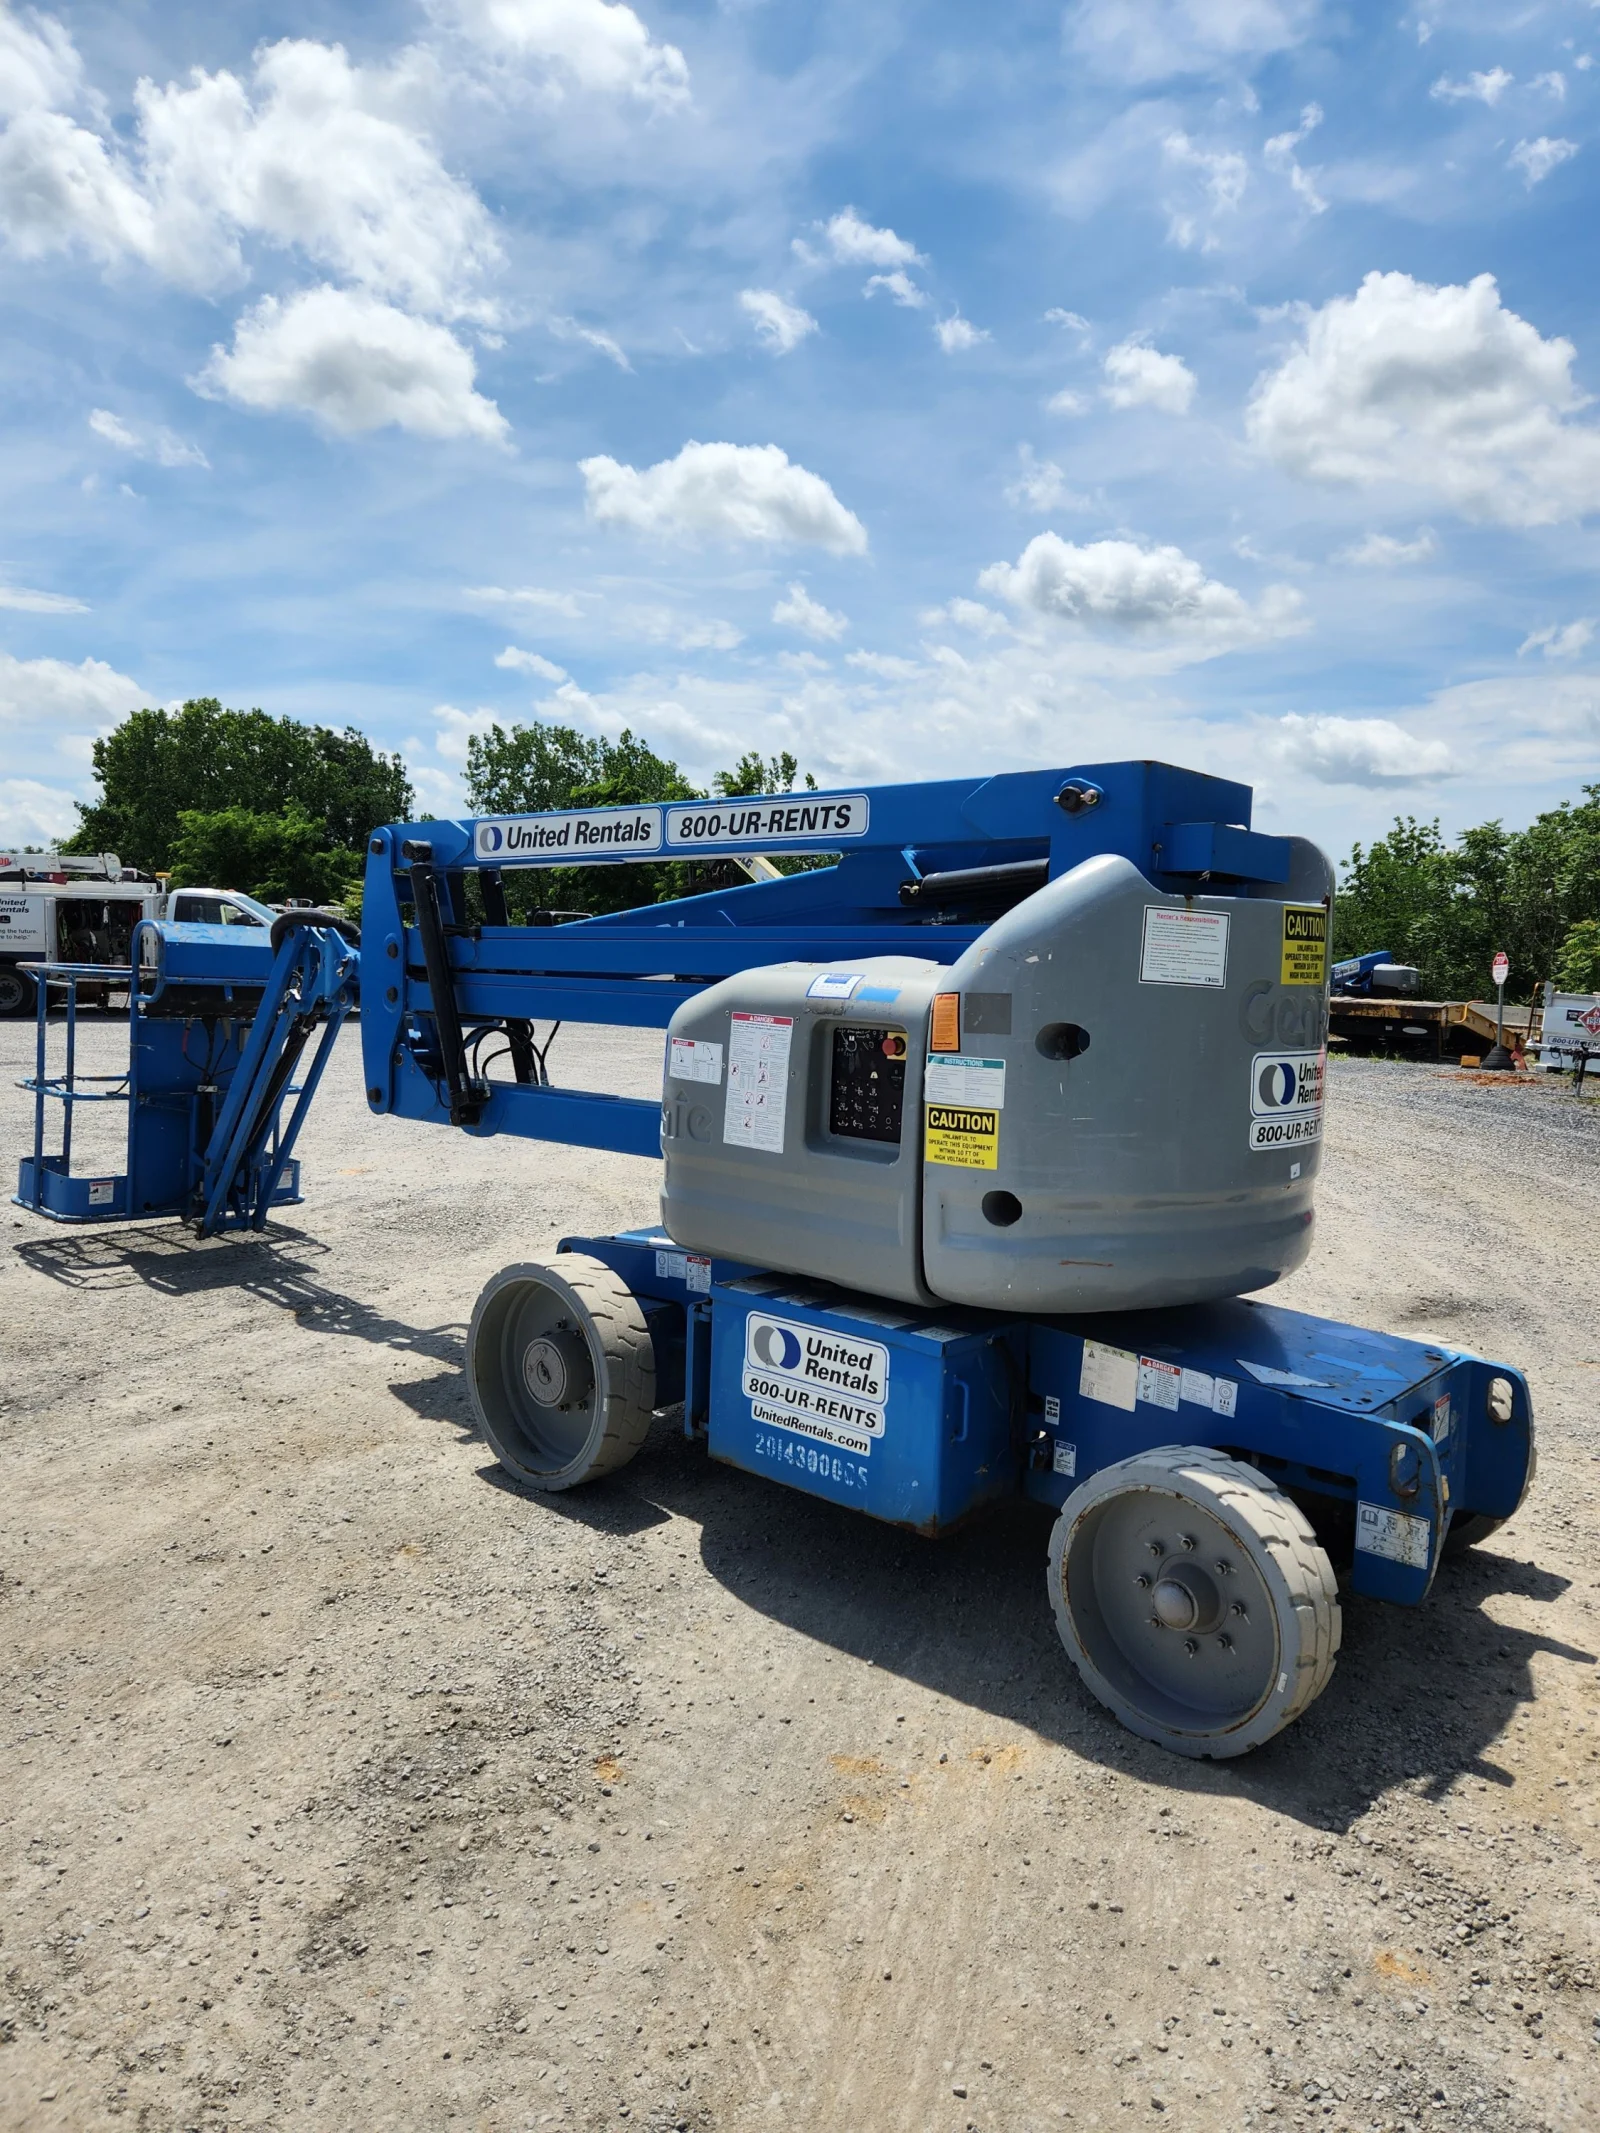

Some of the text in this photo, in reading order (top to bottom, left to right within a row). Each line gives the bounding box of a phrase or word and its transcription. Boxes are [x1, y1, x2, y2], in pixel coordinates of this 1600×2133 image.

[679, 804, 852, 838] 800-UR-RENTS
[507, 816, 651, 849] United Rentals
[0, 898, 26, 906] nited
[1287, 914, 1325, 937] CAUTION
[754, 1016, 774, 1024] DANGER
[944, 1058, 984, 1067] INSTRUCTIONS
[930, 1110, 993, 1132] CAUTION
[928, 1138, 948, 1146] OPERATE
[962, 1143, 994, 1151] EQUIPMENT
[942, 1133, 968, 1141] UNLAWFUL
[947, 1155, 968, 1163] VOLTAGE
[806, 1337, 873, 1371] United
[805, 1358, 878, 1394] Rentals
[1152, 1361, 1175, 1373] DANGER
[749, 1378, 877, 1429] 800-UR-RENTS
[753, 1405, 868, 1452] UnitedRentals.com
